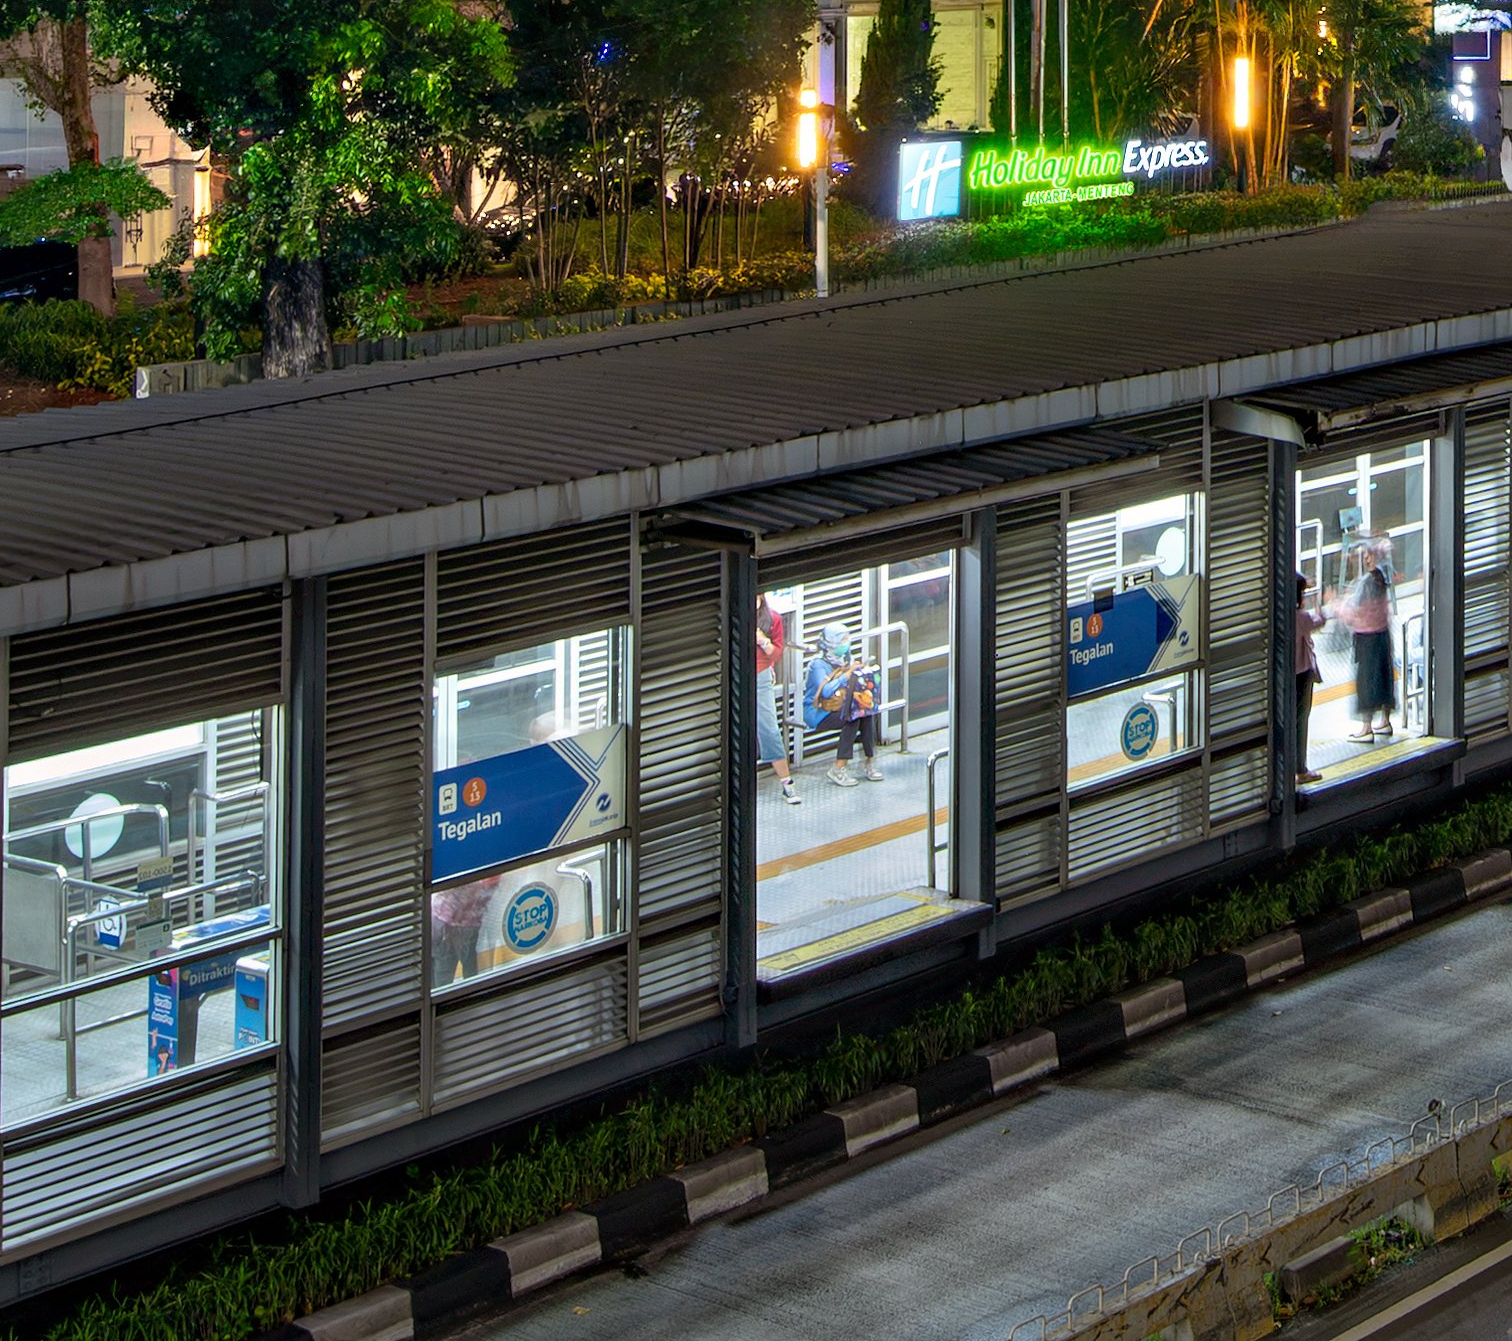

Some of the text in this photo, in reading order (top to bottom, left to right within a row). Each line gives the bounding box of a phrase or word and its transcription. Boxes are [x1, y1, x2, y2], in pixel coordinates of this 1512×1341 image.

[971, 140, 1207, 188] Holiday Inn Express
[1070, 642, 1113, 665] Tegalan
[1128, 720, 1150, 737] STOP
[438, 811, 501, 841] Tegalan
[515, 903, 547, 925] STOP
